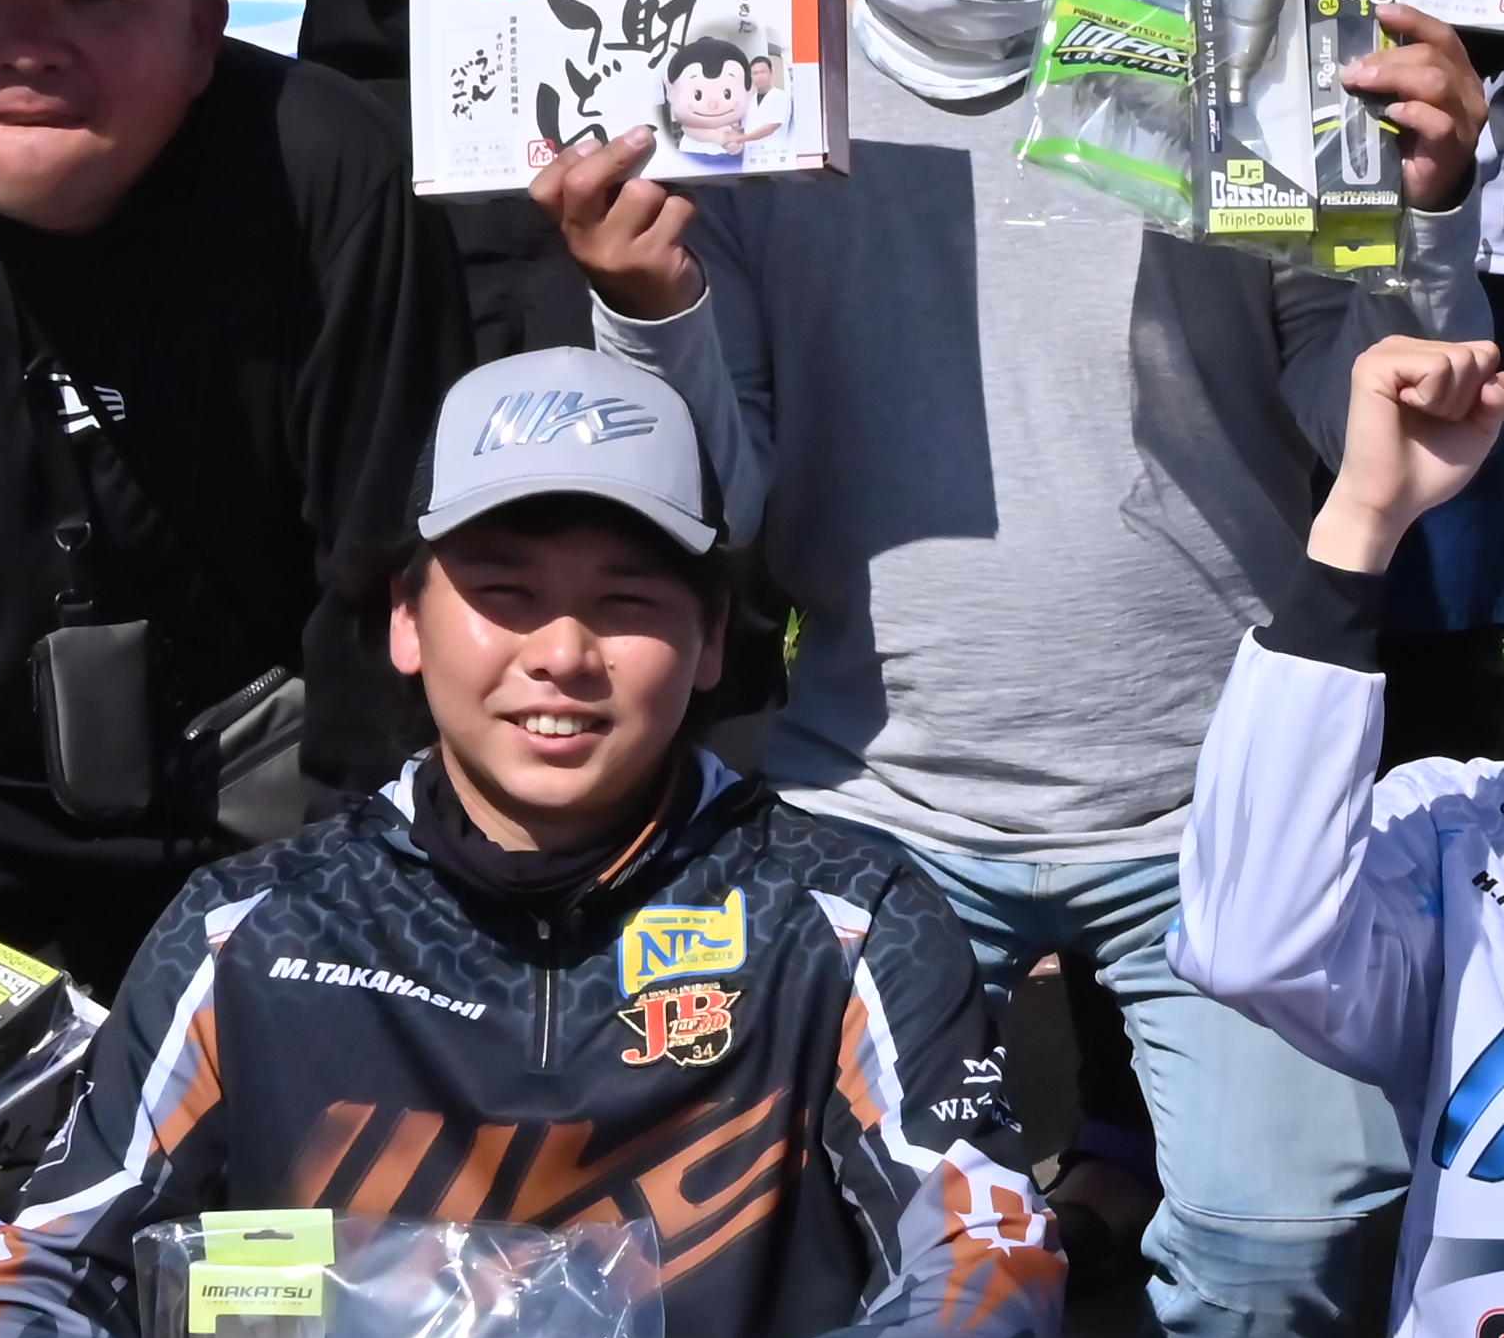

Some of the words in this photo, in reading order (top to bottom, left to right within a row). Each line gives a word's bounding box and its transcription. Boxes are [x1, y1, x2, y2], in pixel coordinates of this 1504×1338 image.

[1219, 213, 1306, 230] TripleDouble
[270, 957, 486, 1021] M.TAKAHASHI
[201, 1284, 313, 1300] IMAKATSU
